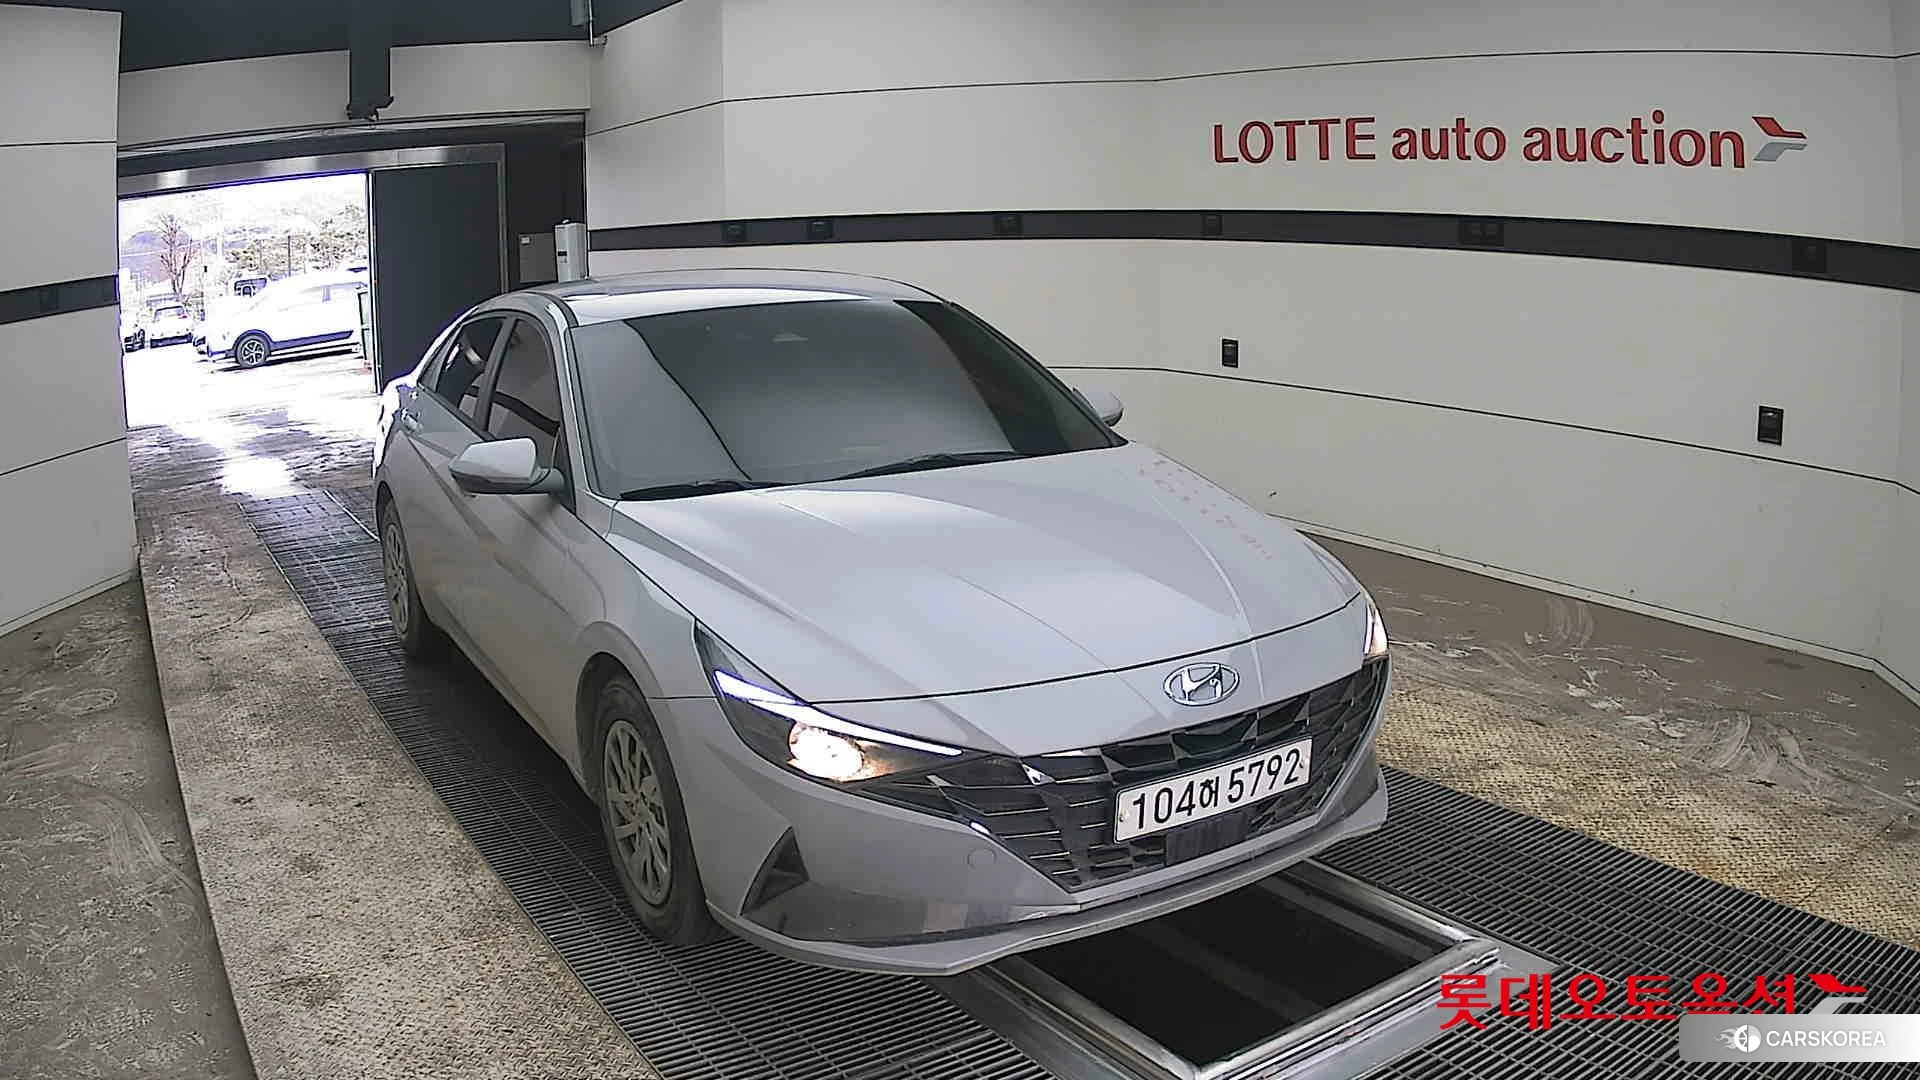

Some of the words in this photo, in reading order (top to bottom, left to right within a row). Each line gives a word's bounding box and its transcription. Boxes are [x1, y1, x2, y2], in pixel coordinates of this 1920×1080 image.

[1213, 116, 1376, 164] LOTTE
[1391, 117, 1507, 161] auto
[1523, 110, 1747, 169] auction
[1132, 776, 1220, 830] 104허
[1227, 747, 1301, 804] 5792
